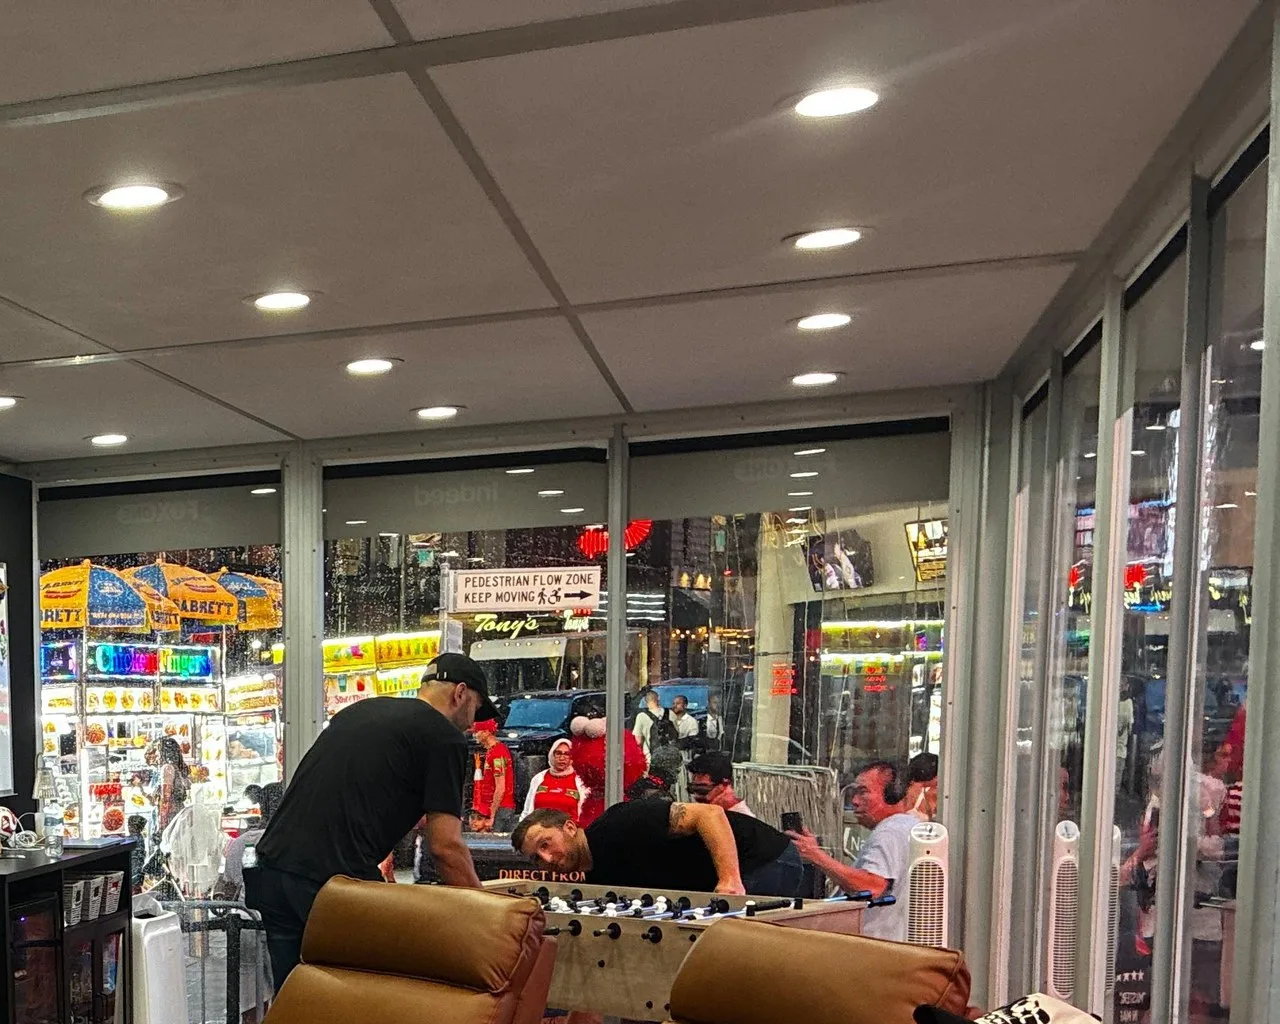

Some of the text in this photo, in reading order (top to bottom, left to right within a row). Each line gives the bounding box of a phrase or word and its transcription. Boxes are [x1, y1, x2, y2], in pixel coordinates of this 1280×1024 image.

[464, 573, 593, 588] PEDESTRIAN FLOW ZONE
[464, 591, 535, 603] KEEP MOVING
[172, 598, 234, 616] SABRETT
[474, 613, 539, 639] Tony's
[95, 644, 159, 675] Chicken
[160, 645, 211, 678] Fingers
[500, 869, 549, 881] DIRECT
